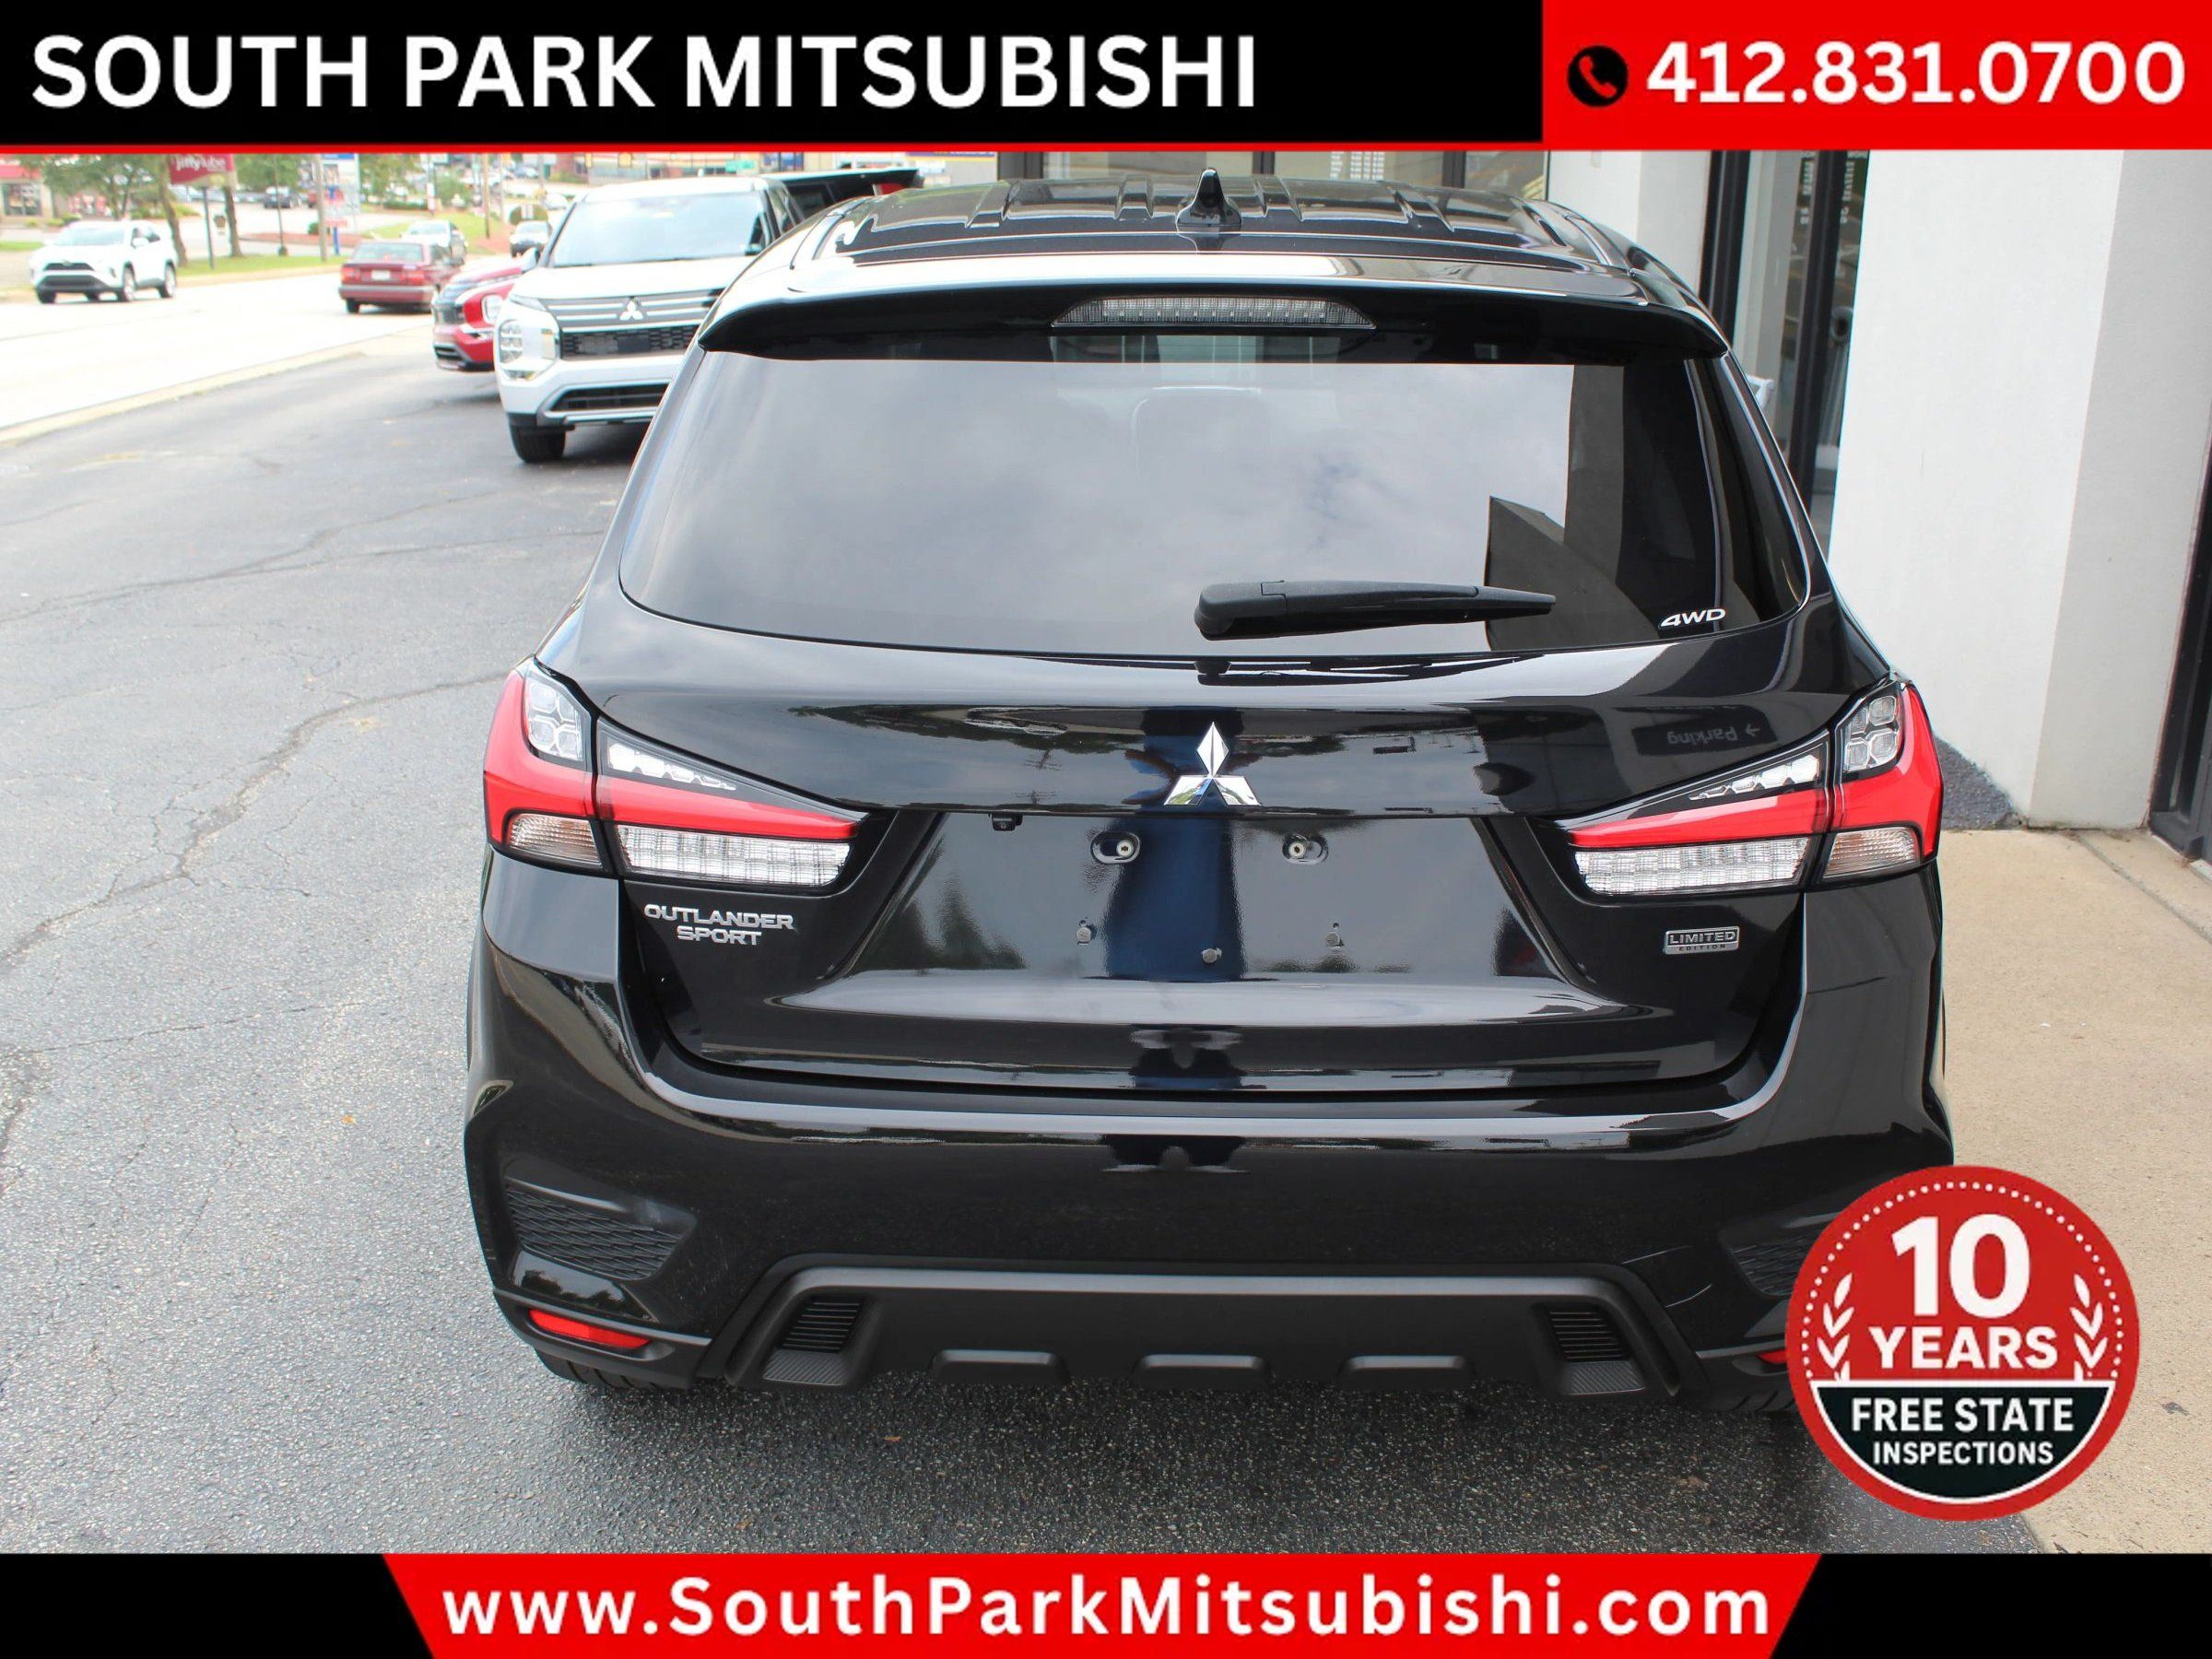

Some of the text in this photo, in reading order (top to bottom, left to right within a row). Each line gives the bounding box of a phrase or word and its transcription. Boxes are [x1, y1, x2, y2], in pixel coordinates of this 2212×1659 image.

[1660, 608, 1726, 627] 4WD
[644, 903, 796, 930] OUTLANDER
[677, 925, 762, 946] SPORT
[1669, 931, 1735, 945] LIMITED
[1678, 944, 1726, 952] EDITION
